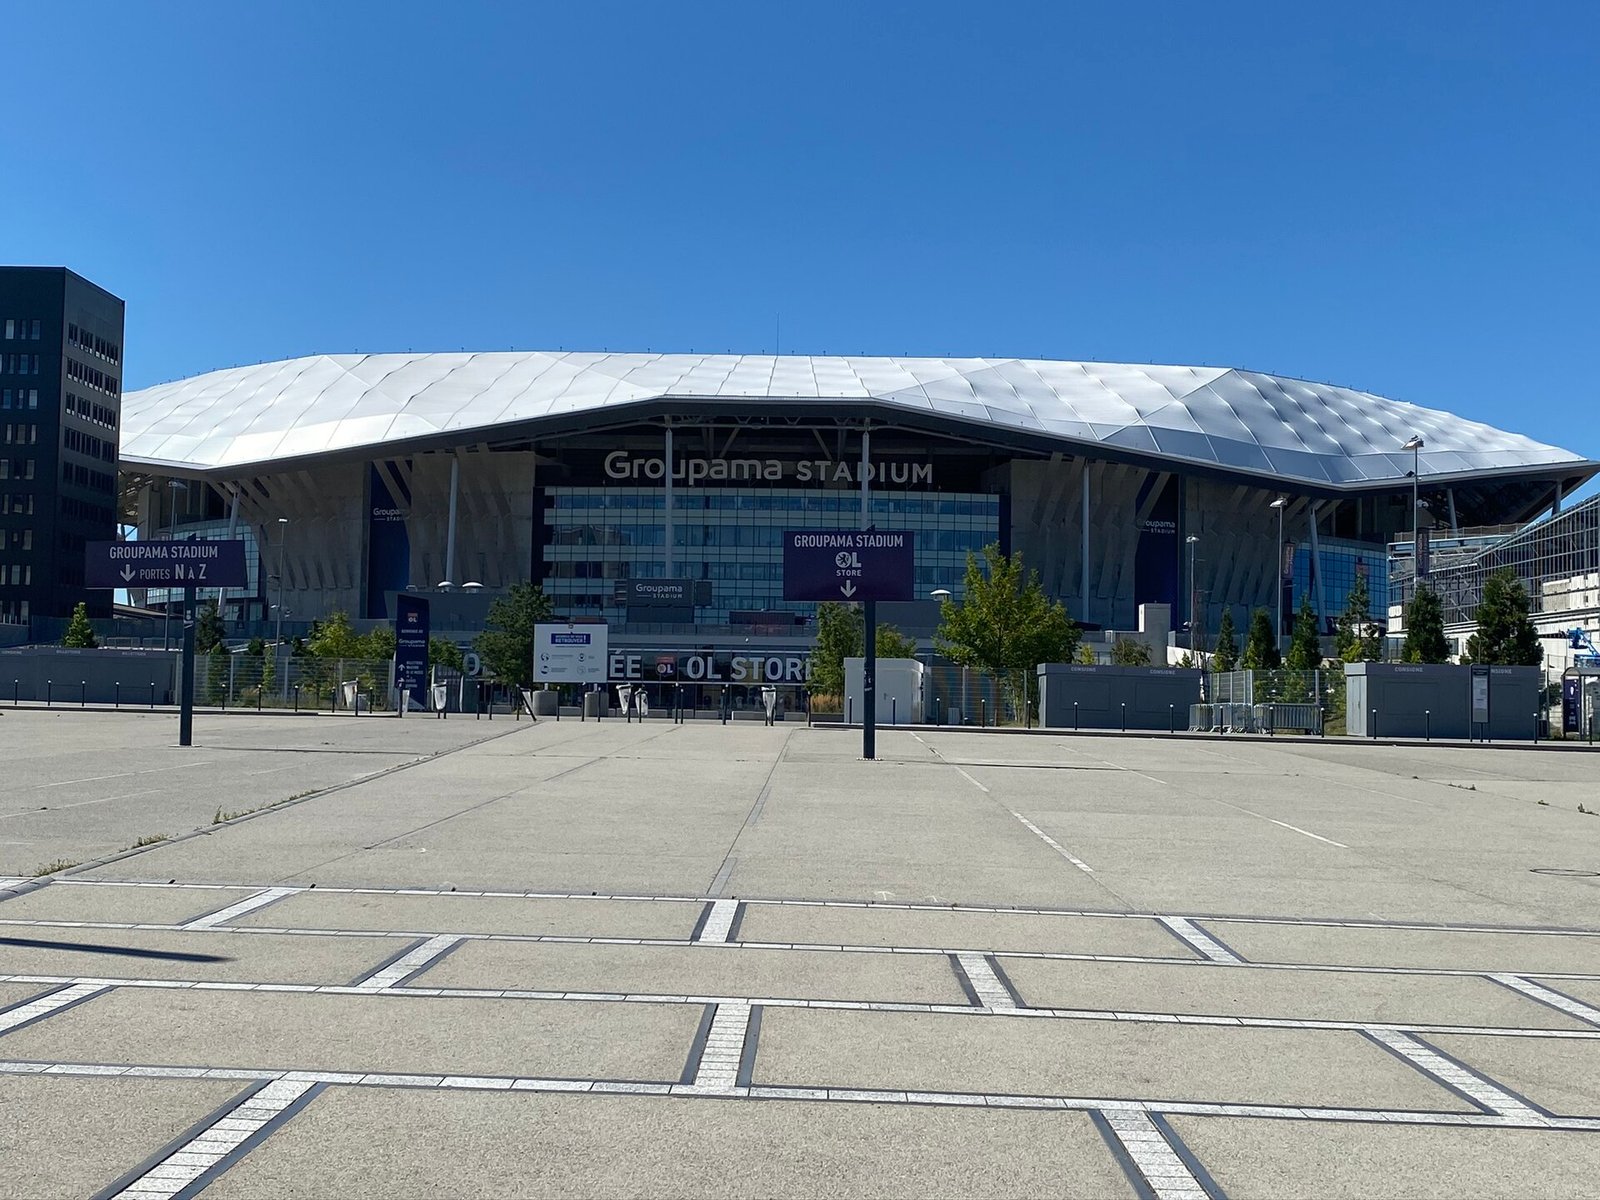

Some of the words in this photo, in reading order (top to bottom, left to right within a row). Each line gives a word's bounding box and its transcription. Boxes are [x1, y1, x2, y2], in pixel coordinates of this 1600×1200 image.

[604, 451, 782, 485] Groupama
[796, 460, 933, 483] STADIUM
[373, 507, 401, 516] Groupa
[794, 535, 853, 547] GROUPAMA
[856, 535, 903, 547] STADIUM
[109, 547, 168, 559] GROUPAMA
[171, 546, 218, 558] STADIUM
[836, 552, 861, 568] OL
[140, 569, 170, 579] PORTES
[175, 564, 184, 579] N
[199, 564, 206, 579] Z
[635, 584, 683, 593] Groupama
[687, 656, 721, 679] OL
